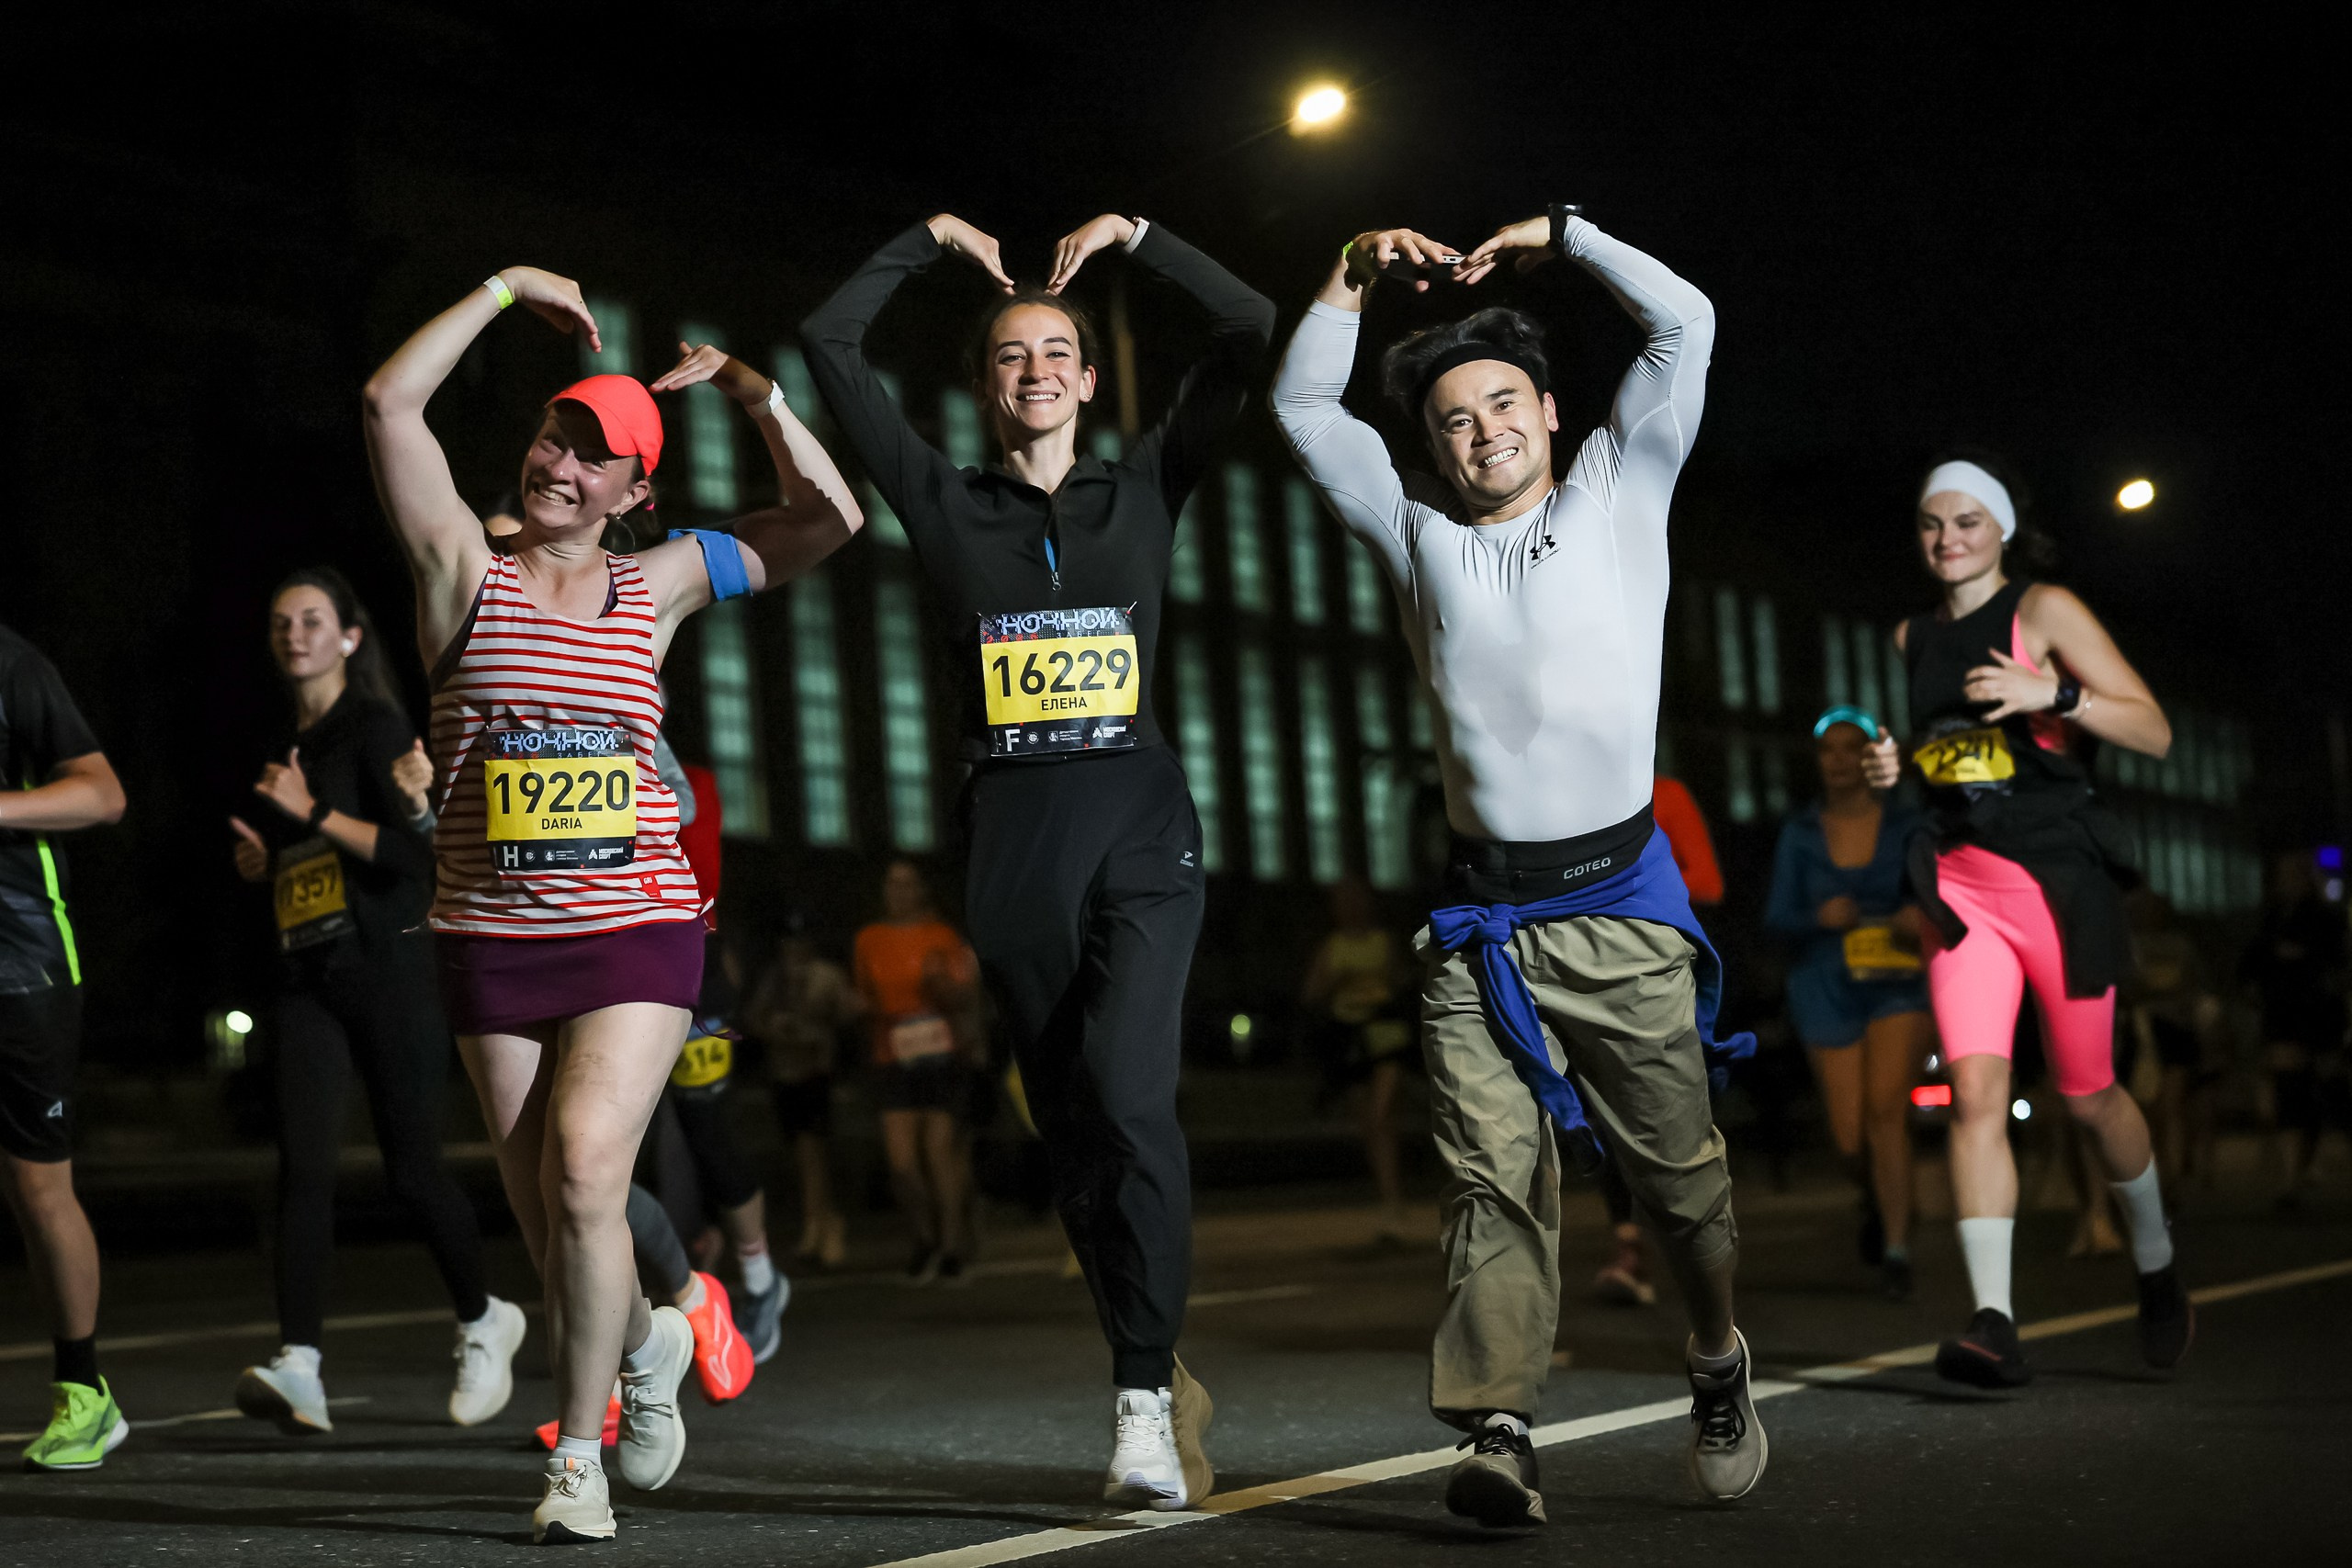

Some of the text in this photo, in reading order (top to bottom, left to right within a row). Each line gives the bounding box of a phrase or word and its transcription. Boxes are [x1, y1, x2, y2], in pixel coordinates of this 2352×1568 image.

[996, 607, 1119, 635] НОЧНОЙ
[1057, 629, 1102, 638] ЗАБЕГ
[992, 649, 1131, 697] 16229
[1041, 697, 1088, 711] ЕЛЕНА
[500, 729, 618, 752] НОЧНОЙ
[1005, 728, 1021, 751] F
[492, 770, 630, 814] 19220
[541, 818, 582, 829] DARIA
[503, 846, 519, 867] H
